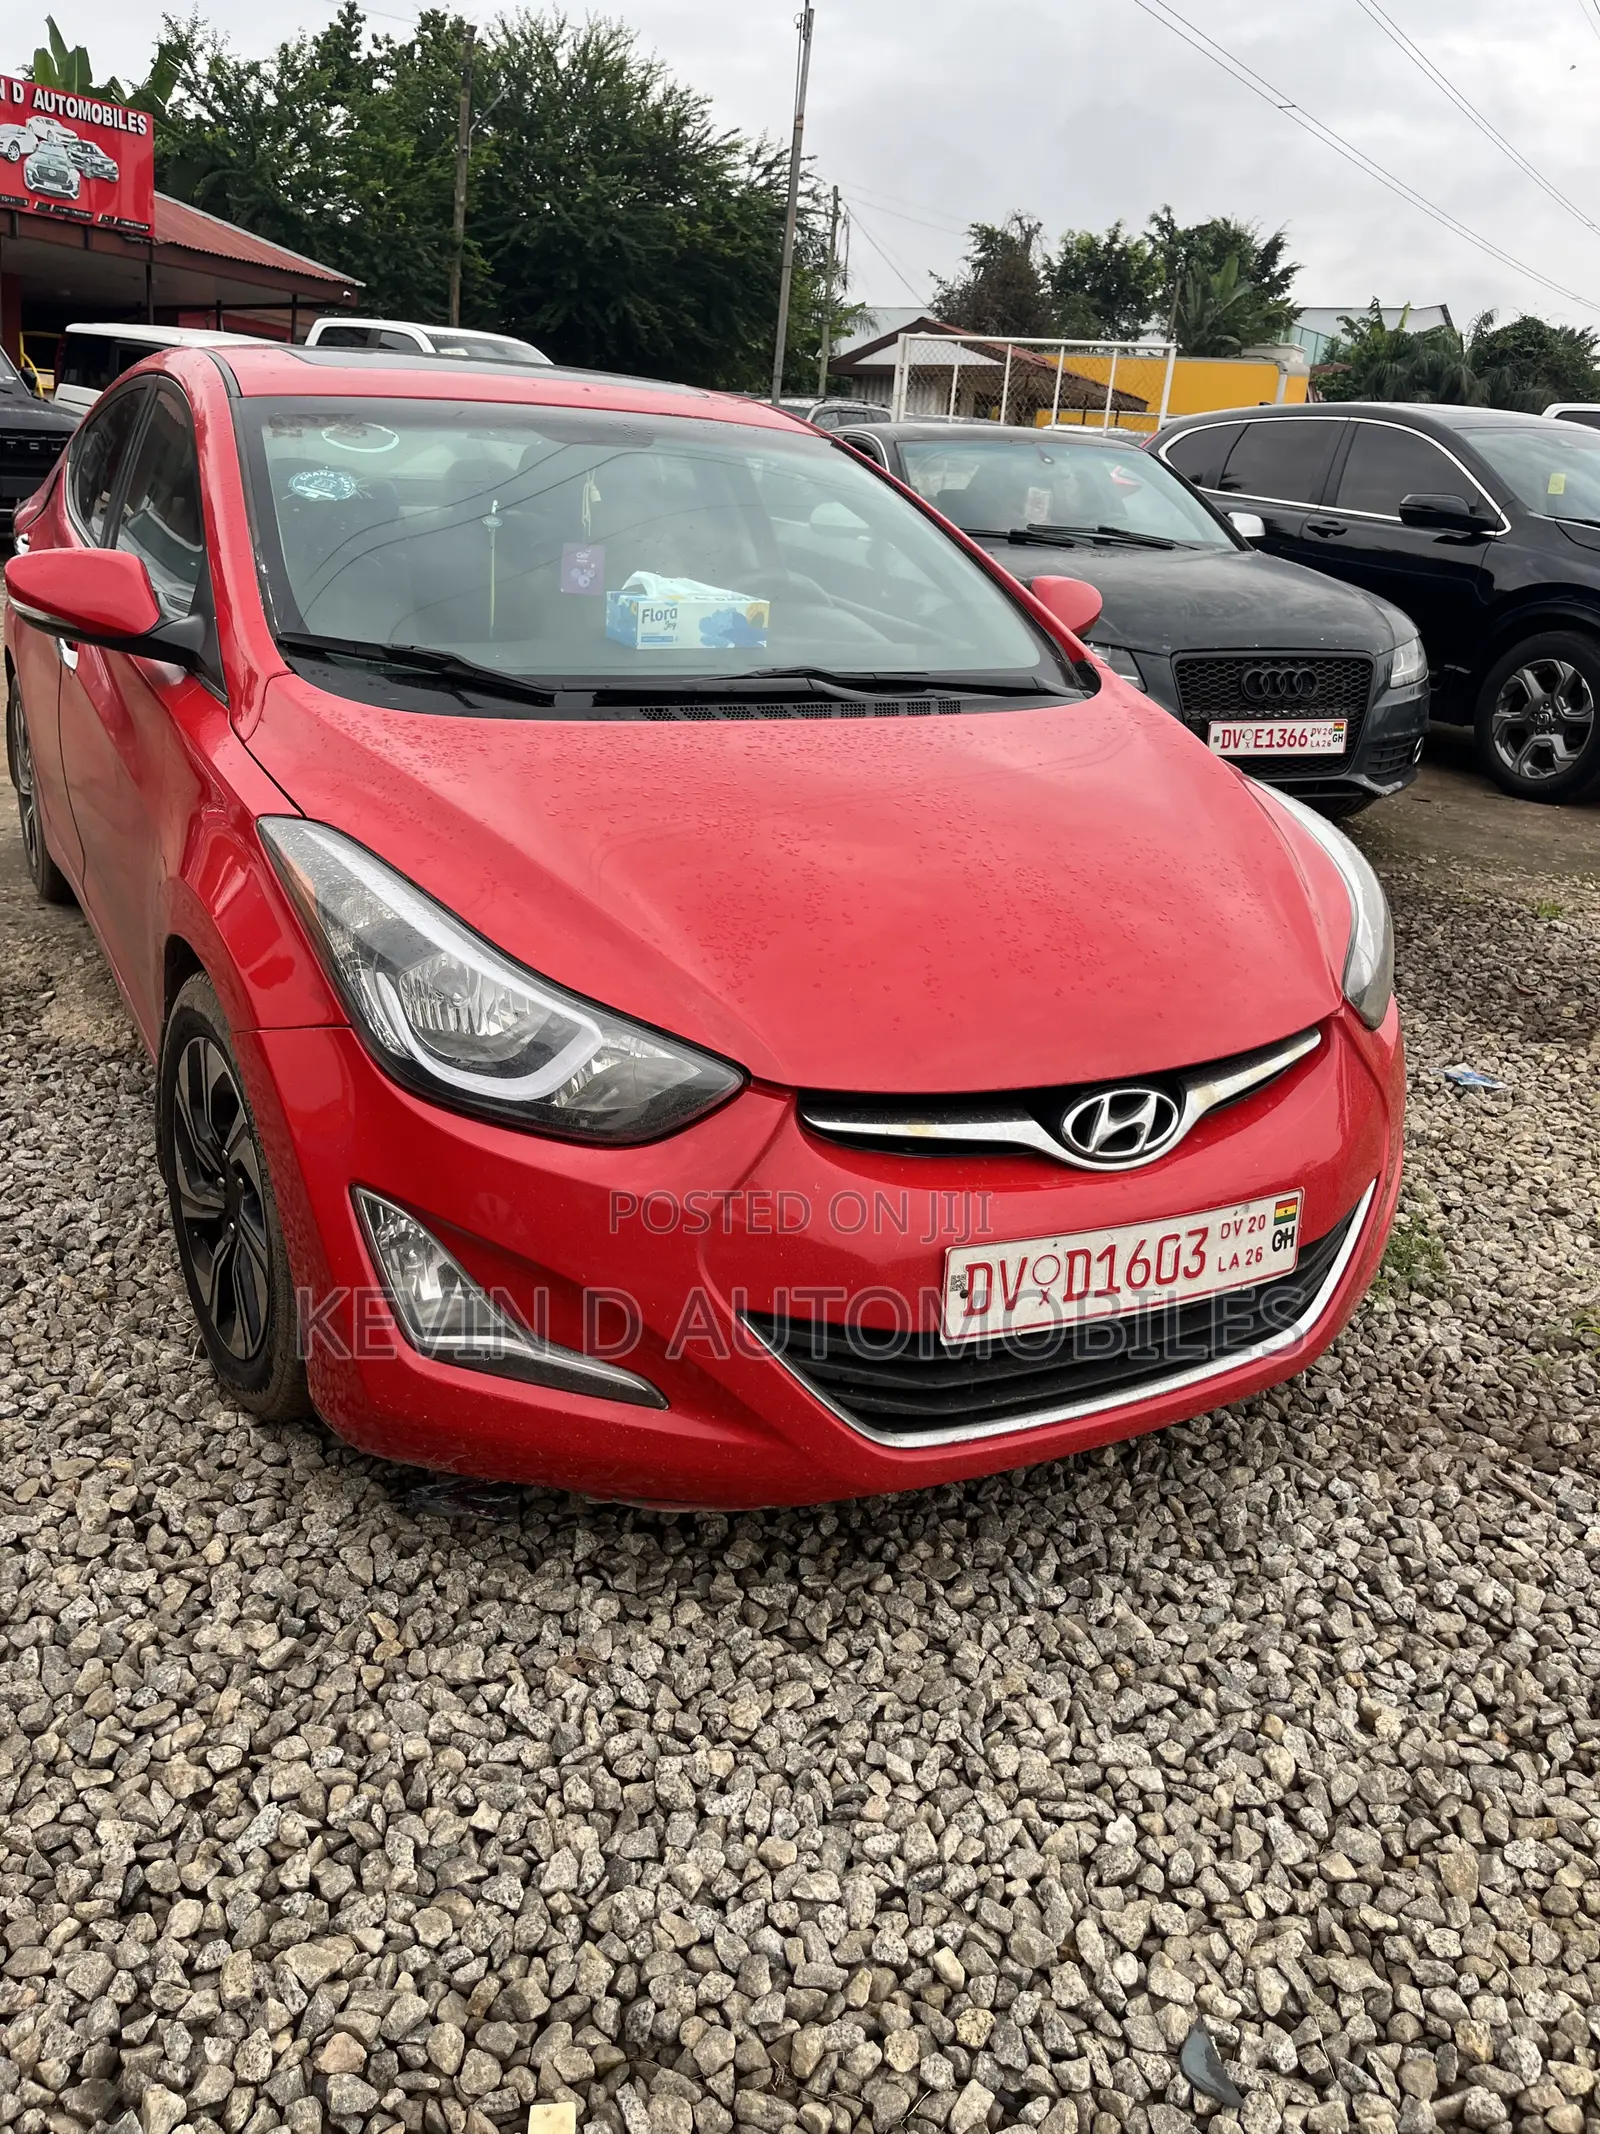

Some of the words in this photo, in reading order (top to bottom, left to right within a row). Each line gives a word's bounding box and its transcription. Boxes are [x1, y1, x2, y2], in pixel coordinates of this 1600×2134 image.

[13, 81, 24, 104] D
[33, 88, 148, 136] AUTOMOBILES
[641, 607, 678, 624] Flora
[663, 620, 677, 631] Joy
[1220, 729, 1243, 749] DV
[1254, 728, 1308, 748] E1366
[1332, 733, 1343, 743] GH
[1271, 1225, 1295, 1252] GH
[963, 1256, 1029, 1317] DV
[1063, 1227, 1210, 1303] D1603
